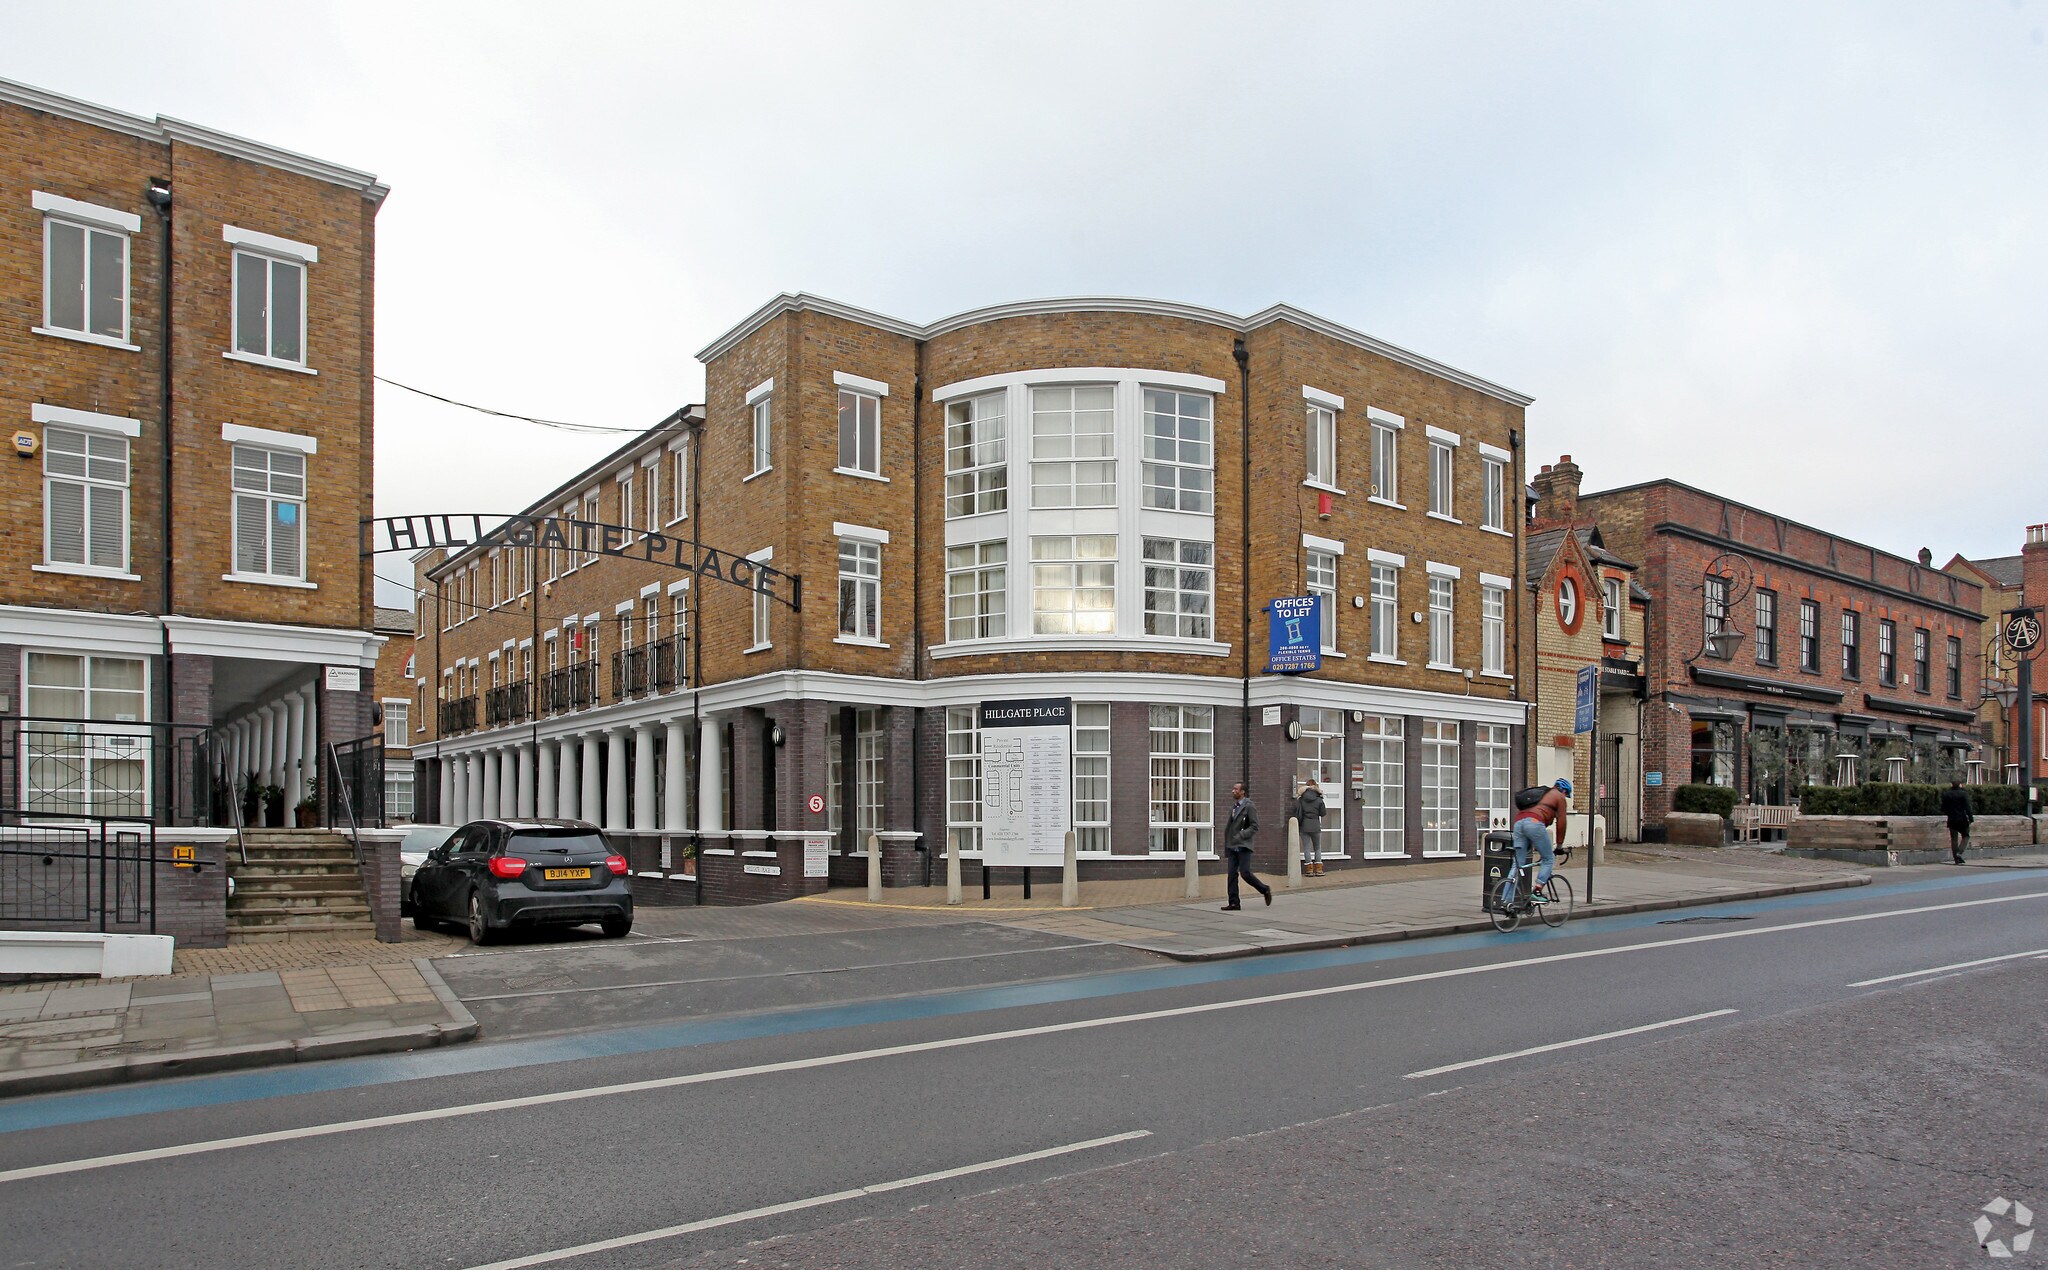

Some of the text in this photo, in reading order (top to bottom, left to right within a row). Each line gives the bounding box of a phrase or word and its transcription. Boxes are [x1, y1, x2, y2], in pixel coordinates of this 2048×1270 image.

[18, 437, 32, 446] ADT
[387, 514, 779, 597] HILLGATE PLACE
[1274, 598, 1313, 608] OFFICES
[1277, 608, 1311, 618] TO LET
[1287, 623, 1301, 639] H
[985, 707, 1066, 719] HILLGATE PLACE
[812, 798, 820, 810] 5
[570, 869, 586, 877] YXP
